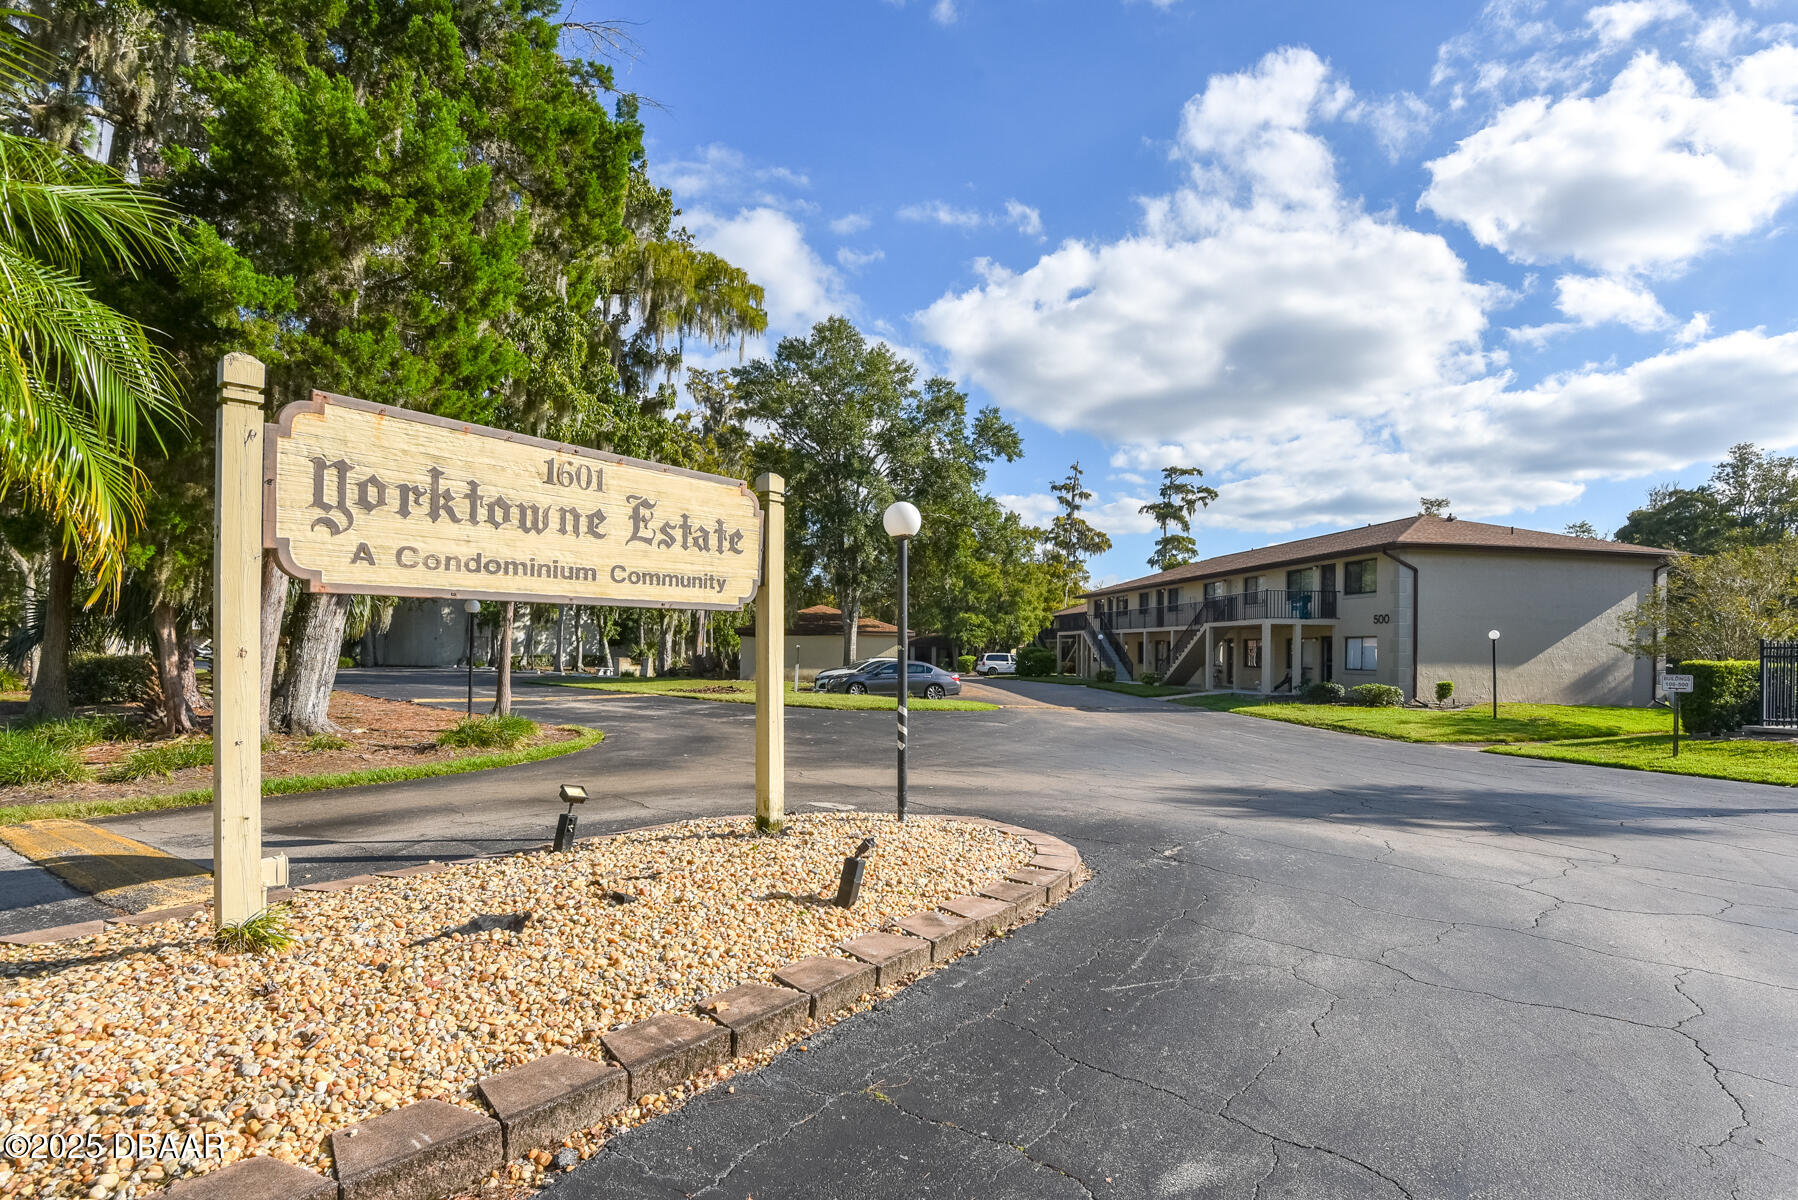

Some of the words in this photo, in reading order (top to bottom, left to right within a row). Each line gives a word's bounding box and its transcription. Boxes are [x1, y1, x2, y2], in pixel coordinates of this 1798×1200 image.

[542, 457, 606, 493] 1601
[305, 454, 608, 539] Yorktowne
[625, 494, 744, 555] Estate
[351, 542, 376, 566] A
[395, 545, 597, 582] Condominium
[610, 564, 727, 594] Community
[1373, 614, 1390, 624] 500
